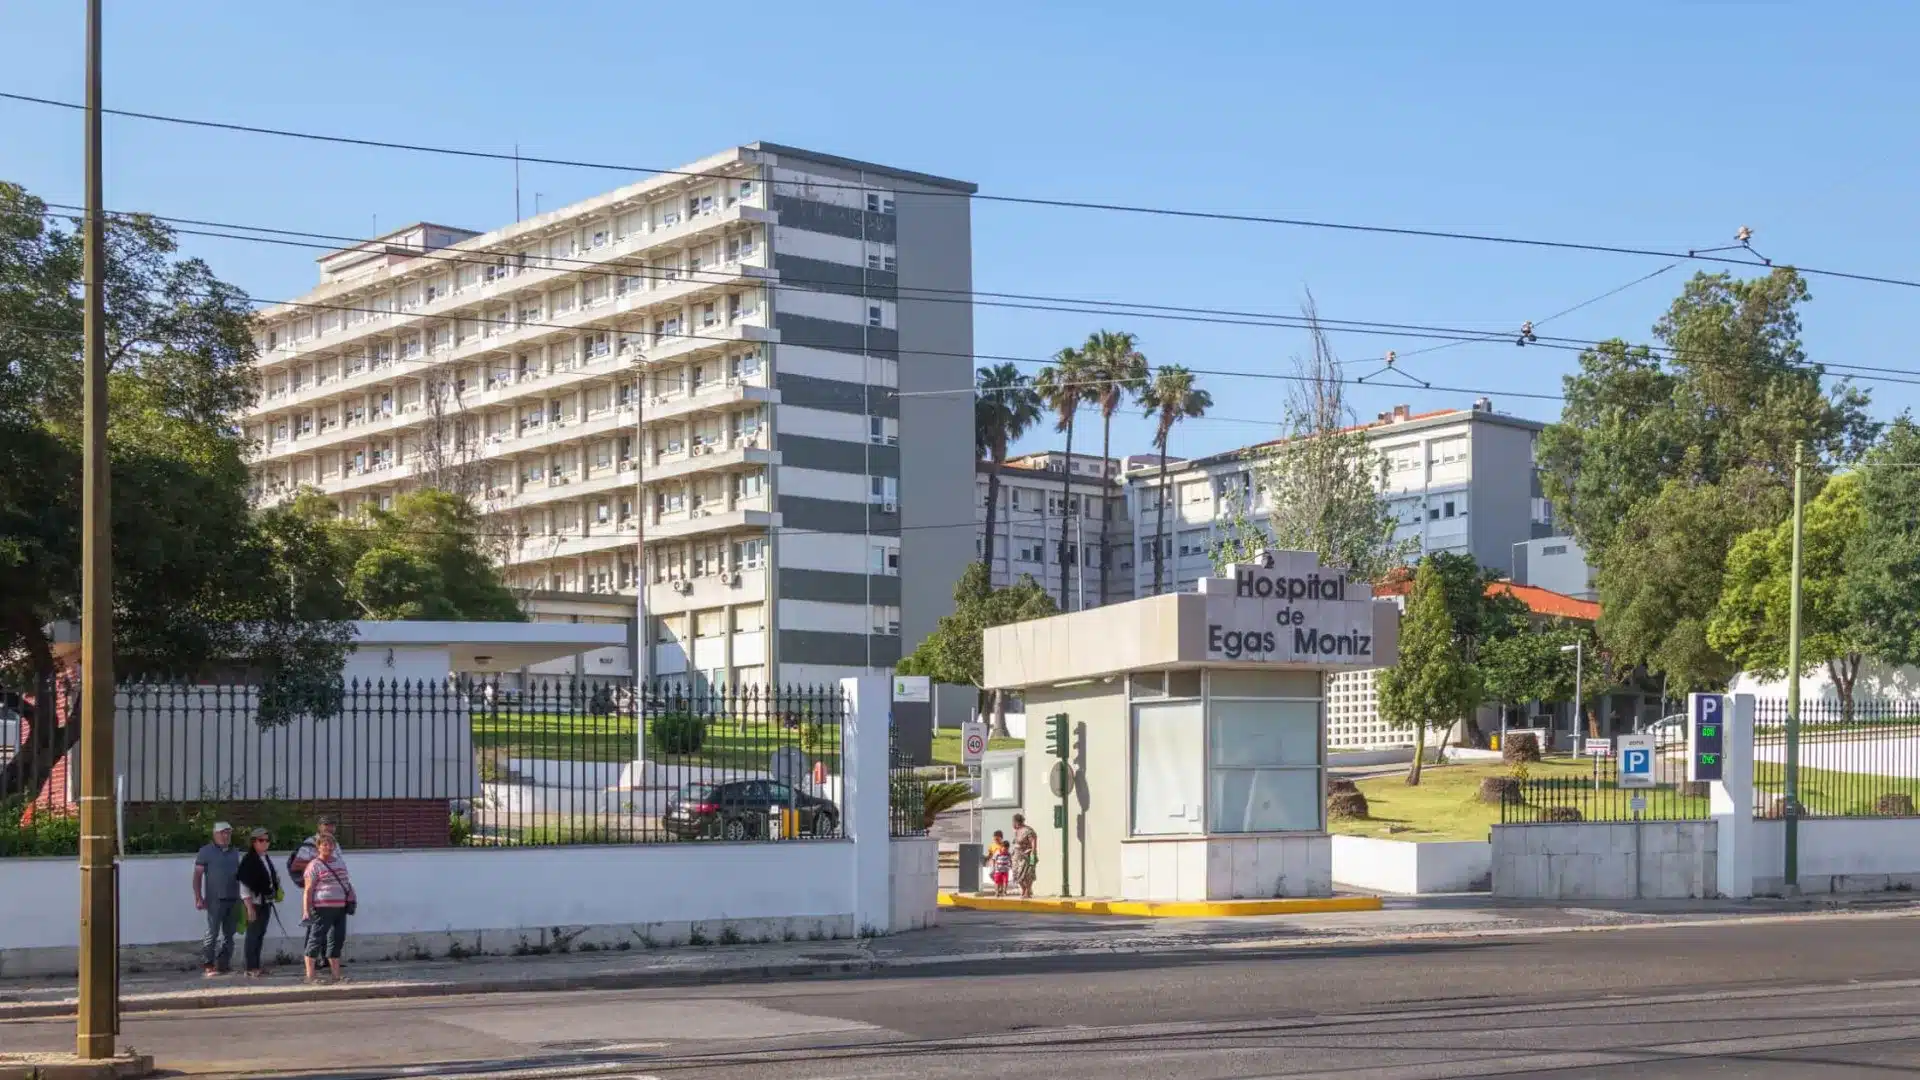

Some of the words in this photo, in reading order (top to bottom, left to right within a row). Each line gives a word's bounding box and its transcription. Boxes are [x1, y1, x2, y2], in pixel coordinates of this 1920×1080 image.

[1236, 570, 1345, 603] Hospital
[1276, 606, 1305, 626] de
[1208, 625, 1275, 659] Egas
[1294, 628, 1372, 656] Moniz
[1703, 697, 1717, 721] P
[970, 740, 981, 748] 40
[1630, 752, 1645, 772] P
